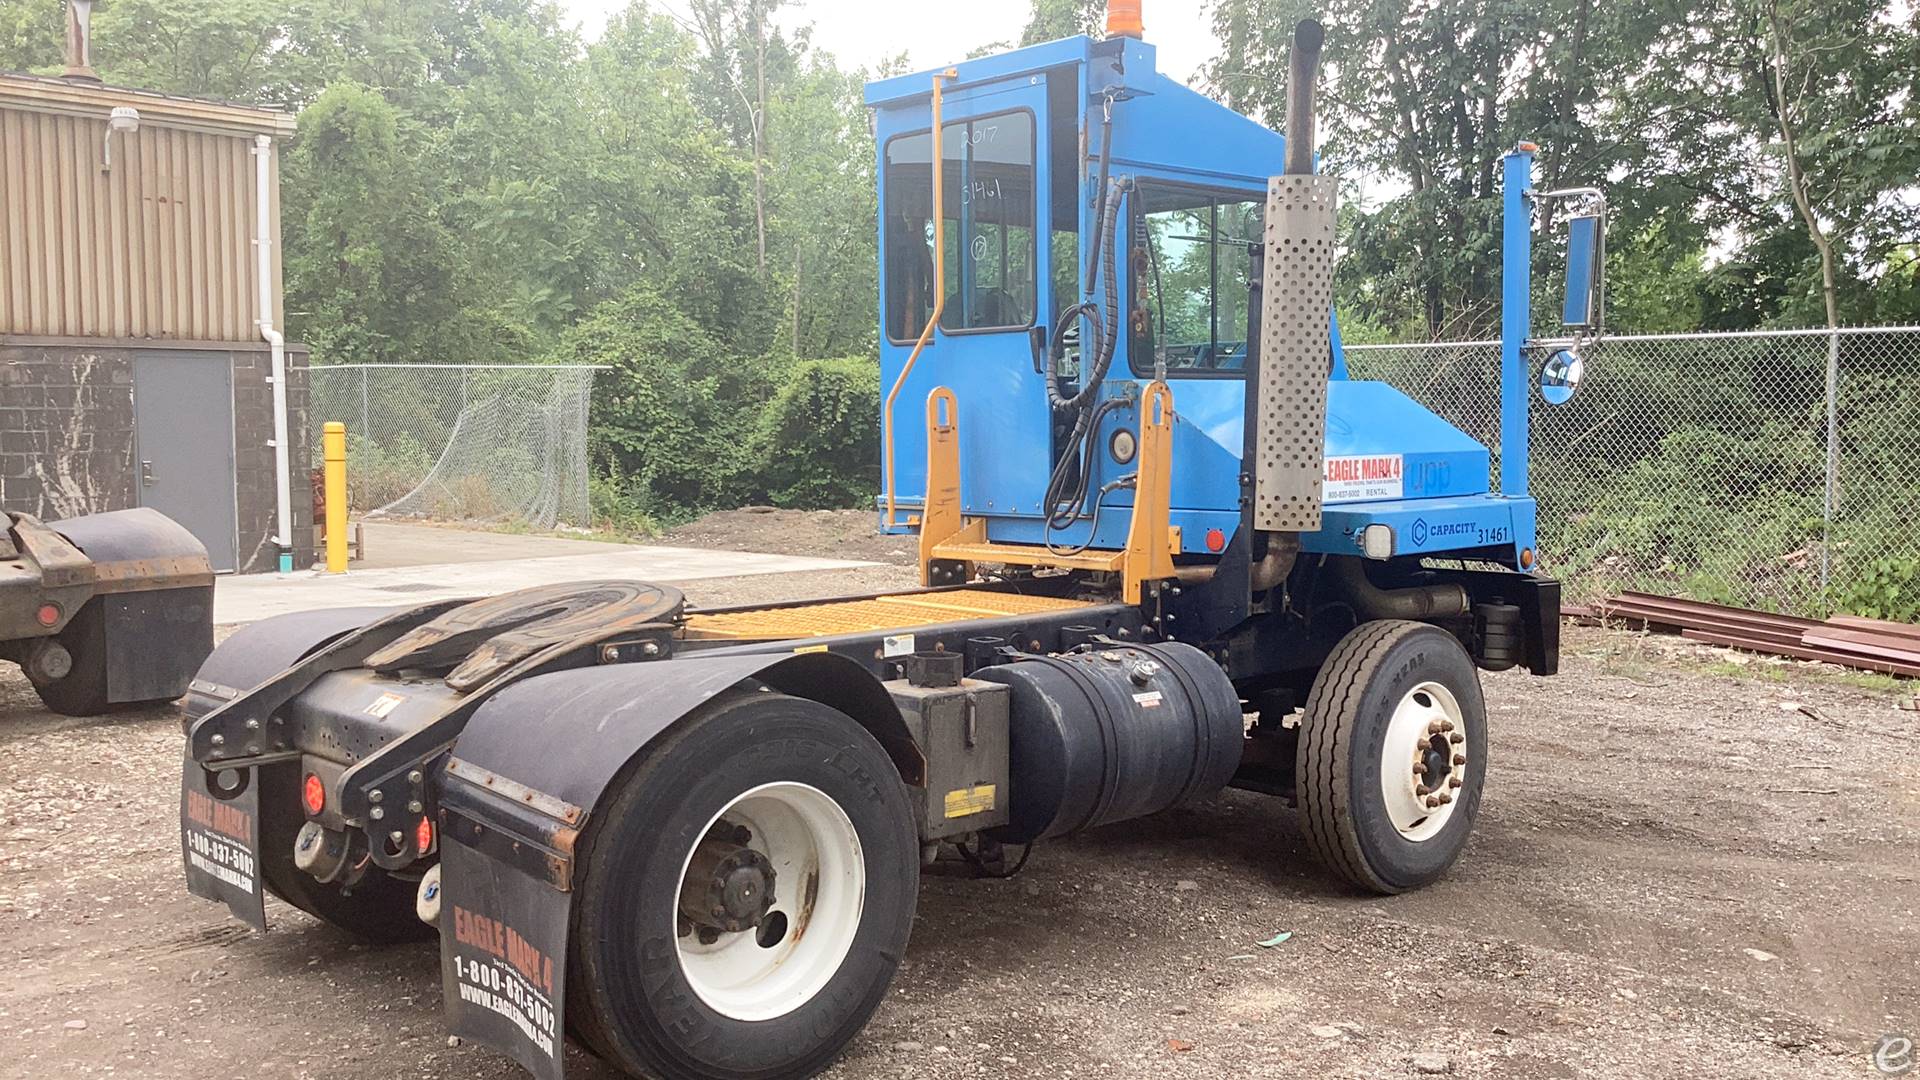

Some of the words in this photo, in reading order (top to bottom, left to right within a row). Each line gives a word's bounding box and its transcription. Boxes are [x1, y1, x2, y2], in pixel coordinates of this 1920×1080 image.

[961, 126, 998, 149] 2017
[1327, 459, 1360, 482] EAGLE
[1361, 458, 1392, 481] MARK
[1392, 457, 1401, 479] 4
[1365, 488, 1389, 497] RENTAL
[1430, 522, 1477, 537] CAPACITY
[1477, 526, 1508, 544] 31461
[186, 829, 254, 878] 1-800-837-5002
[454, 905, 505, 958] EAGLE
[542, 956, 554, 996] 4
[454, 955, 555, 1039] 1-800-837-5002
